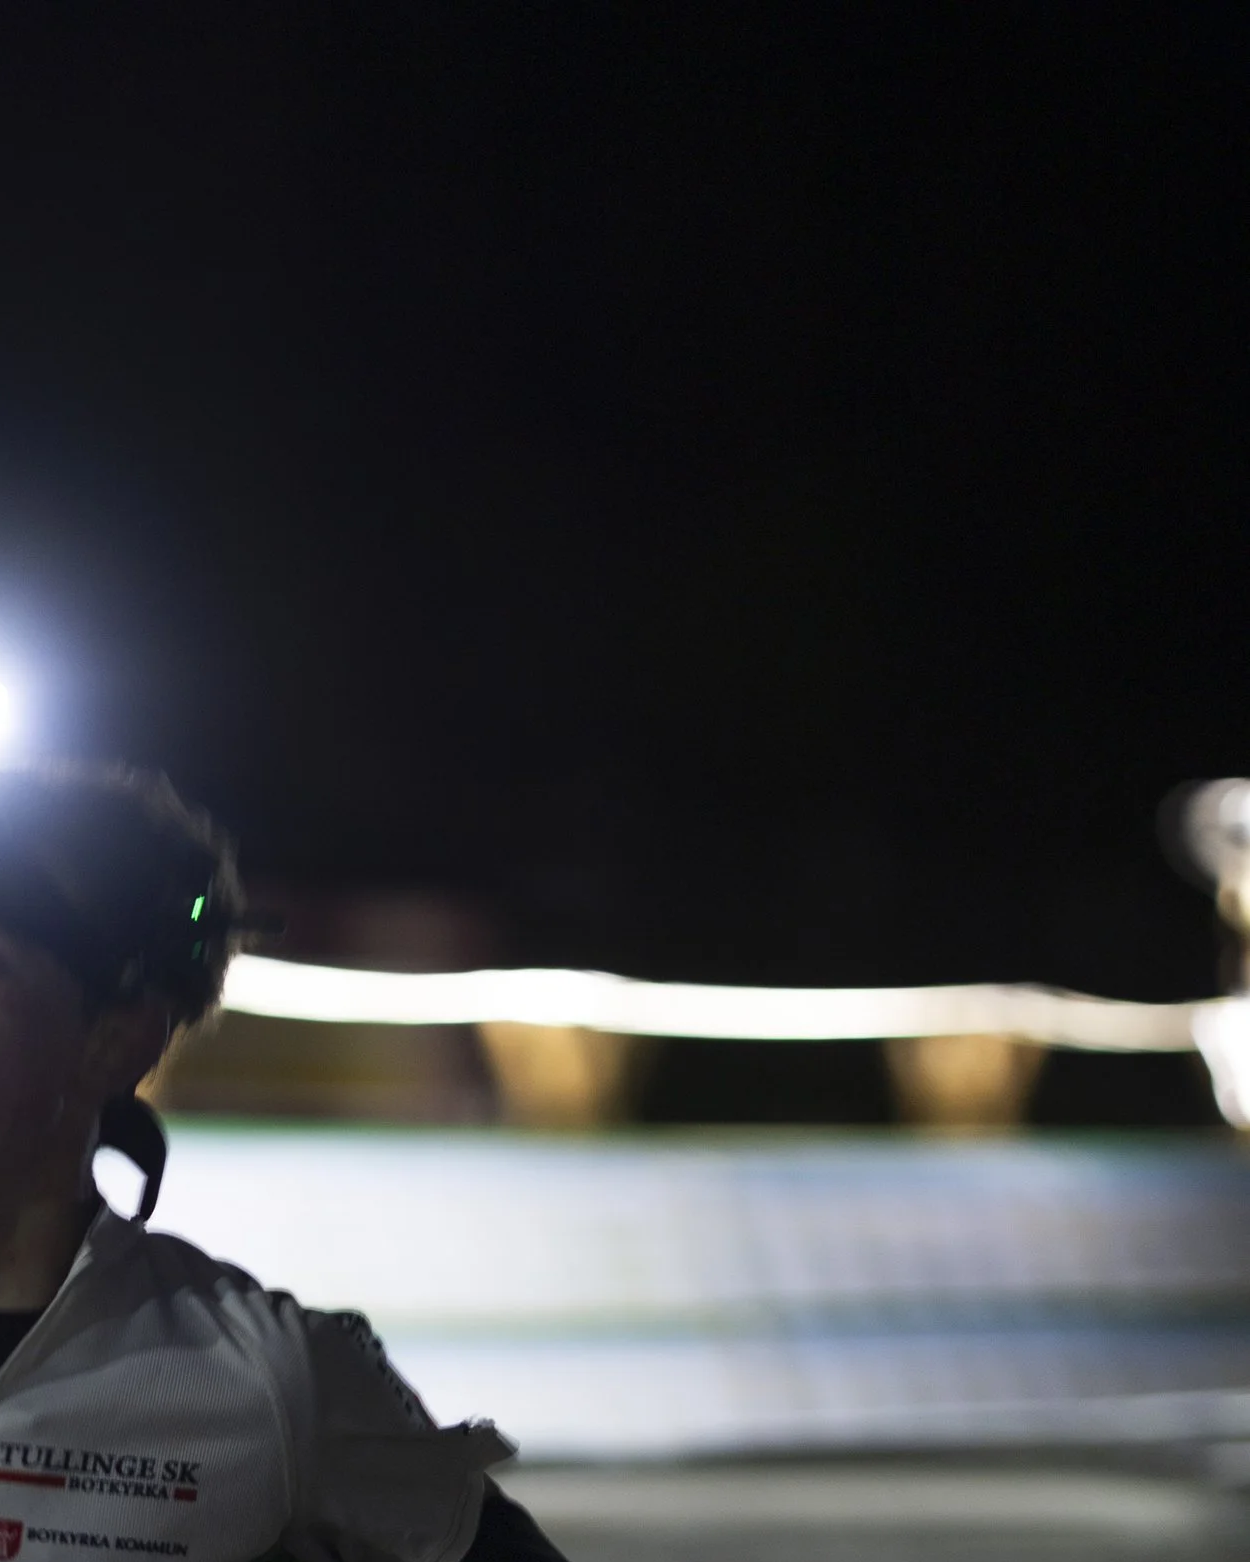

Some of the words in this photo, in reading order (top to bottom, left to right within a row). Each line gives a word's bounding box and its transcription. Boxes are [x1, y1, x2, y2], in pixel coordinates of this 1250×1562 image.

[0, 1442, 156, 1479] TULLINGE
[162, 1460, 199, 1484] SK
[68, 1476, 168, 1500] BOTKYRKA
[27, 1527, 110, 1549] BOTKYRKA
[114, 1536, 188, 1556] KOMMUN
